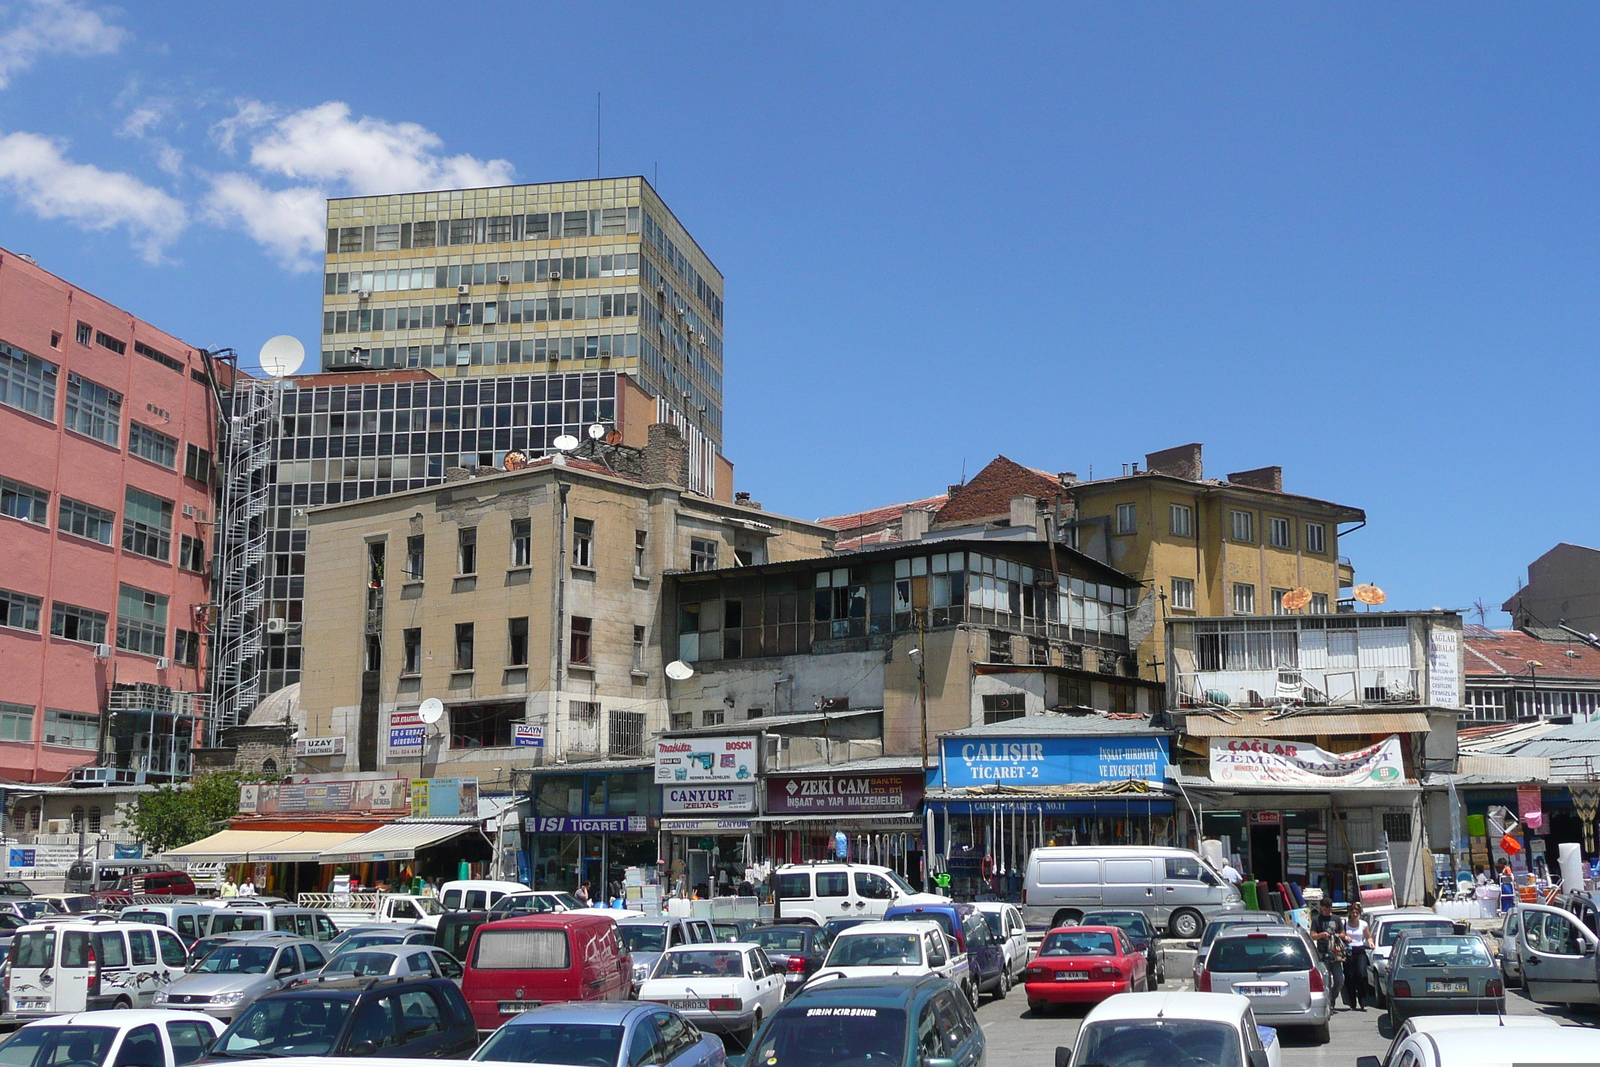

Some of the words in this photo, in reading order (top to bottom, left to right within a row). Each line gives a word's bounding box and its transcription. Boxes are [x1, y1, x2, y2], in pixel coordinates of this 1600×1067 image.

[308, 739, 332, 747] UZAY
[726, 741, 752, 750] BOSCH
[1228, 739, 1298, 757] ÇAĞLAR
[961, 743, 1044, 766] ÇALIŞIR
[970, 764, 1025, 779] TİCARET
[1099, 765, 1108, 777] VE
[1109, 765, 1118, 777] EV
[800, 776, 834, 795] ZEKİ
[837, 778, 870, 794] CAM
[670, 789, 734, 802] CANYURT
[787, 795, 814, 808] İNŞAAT
[828, 797, 844, 806] YAPI
[847, 793, 903, 806] MALZEMELERİ
[667, 821, 700, 829] CANYURT
[717, 820, 752, 828] CANYURT
